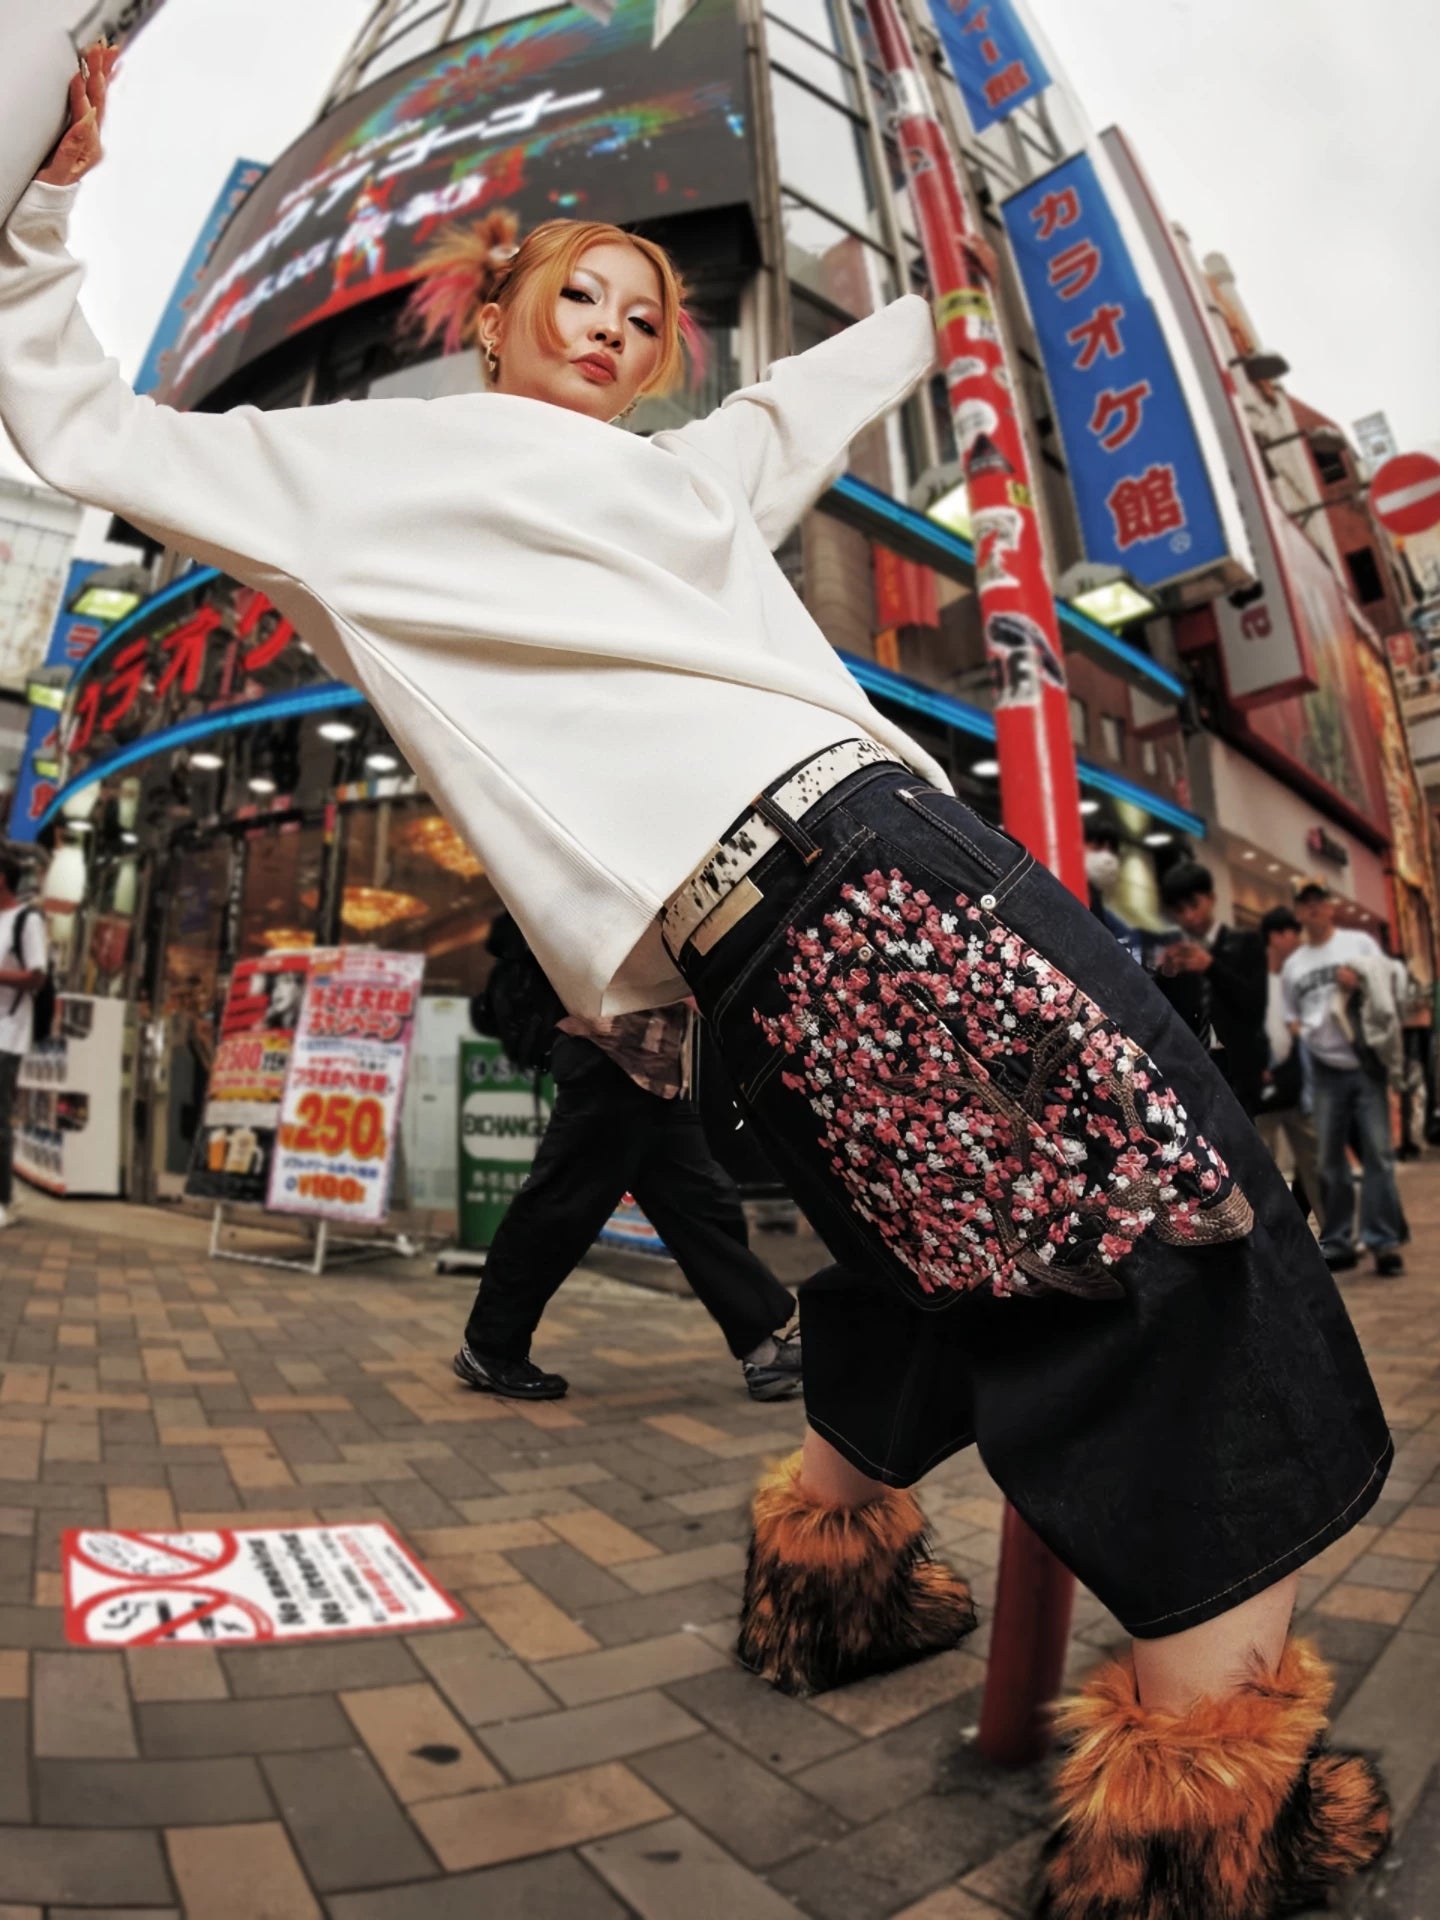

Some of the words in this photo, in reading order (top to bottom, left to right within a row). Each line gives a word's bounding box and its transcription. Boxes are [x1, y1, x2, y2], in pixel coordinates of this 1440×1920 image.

[1030, 186, 1187, 549] カラオケ館
[278, 1601, 305, 1625] No
[320, 1601, 348, 1625] No
